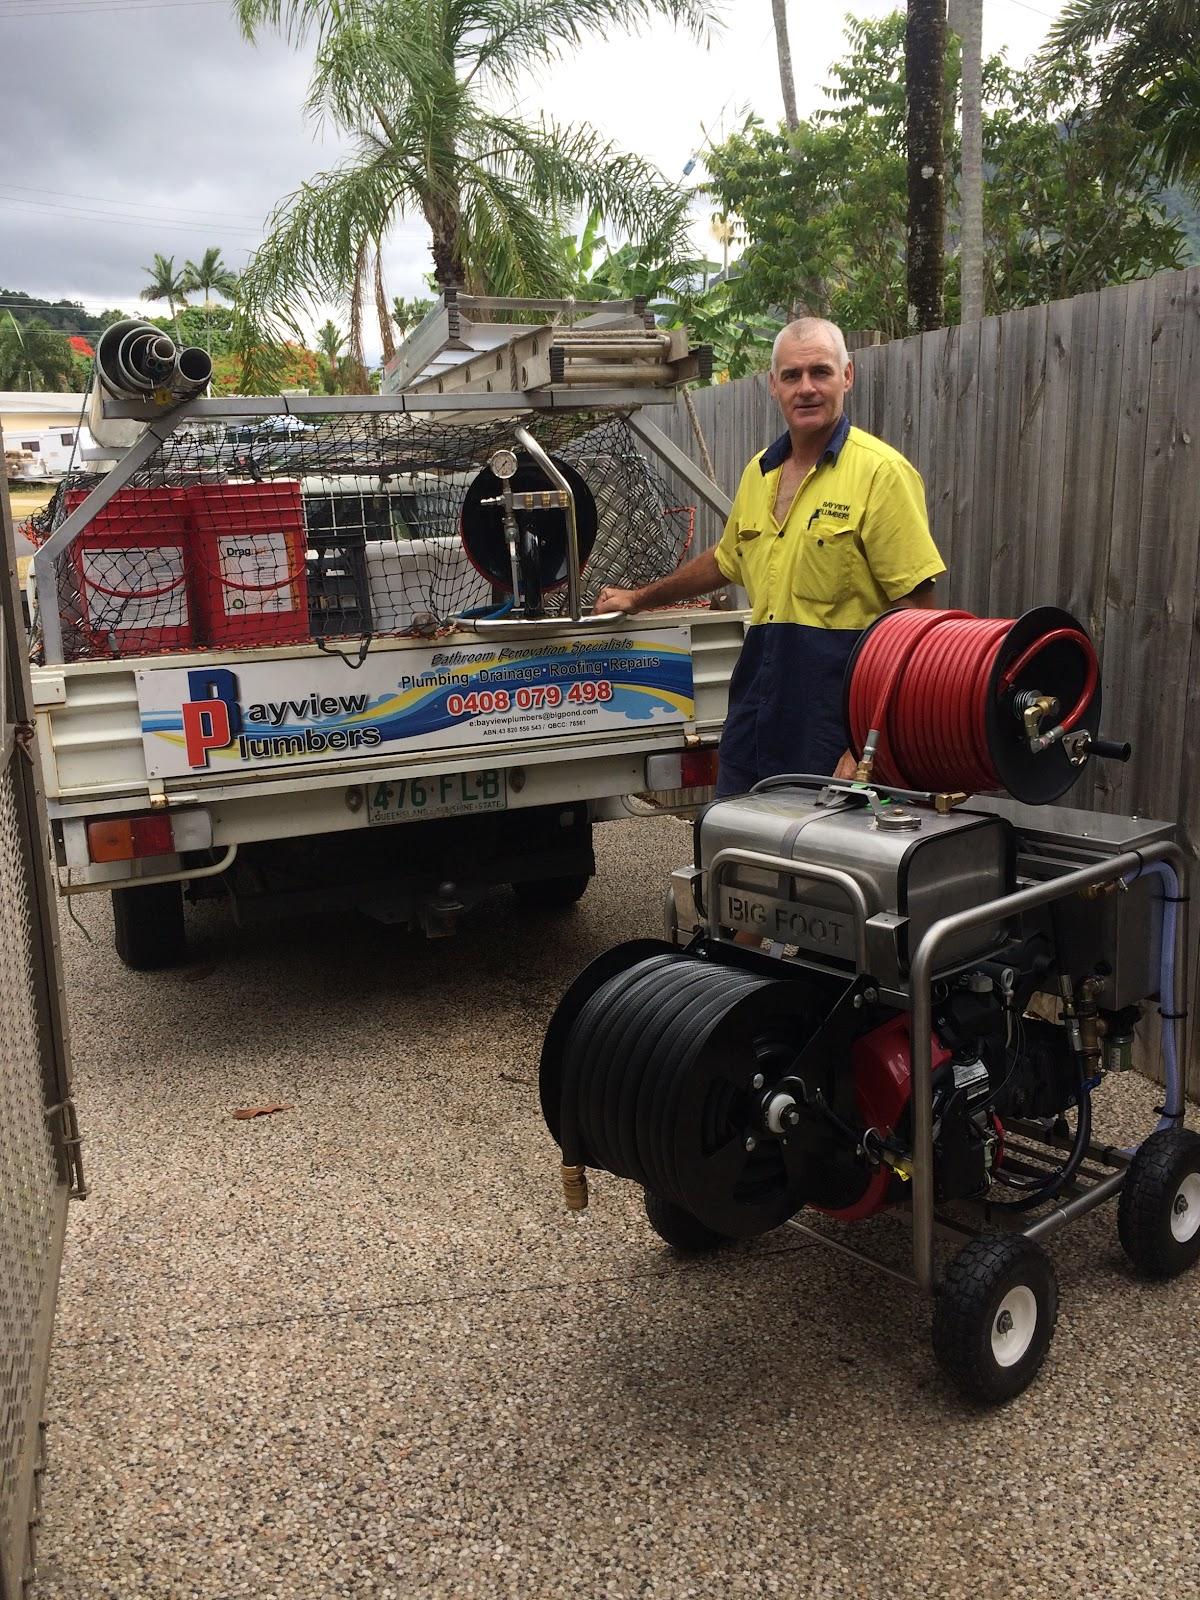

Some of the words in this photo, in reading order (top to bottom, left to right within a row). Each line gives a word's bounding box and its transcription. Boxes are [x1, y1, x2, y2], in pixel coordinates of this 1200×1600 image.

[822, 501, 850, 511] BAYVIEW
[431, 651, 494, 667] Bathroom
[498, 644, 568, 661] Renovation
[571, 638, 634, 657] Specialists
[401, 671, 469, 689] Plumbing
[479, 666, 541, 683] Drainage
[550, 660, 602, 677] Roofing
[609, 655, 660, 672] Repairs
[447, 690, 509, 716] 0408
[516, 685, 561, 709] 079
[567, 680, 612, 703] 498
[373, 778, 427, 811] 476
[440, 770, 500, 803] FLB
[728, 896, 767, 924] BIG
[775, 908, 844, 945] FOOT
